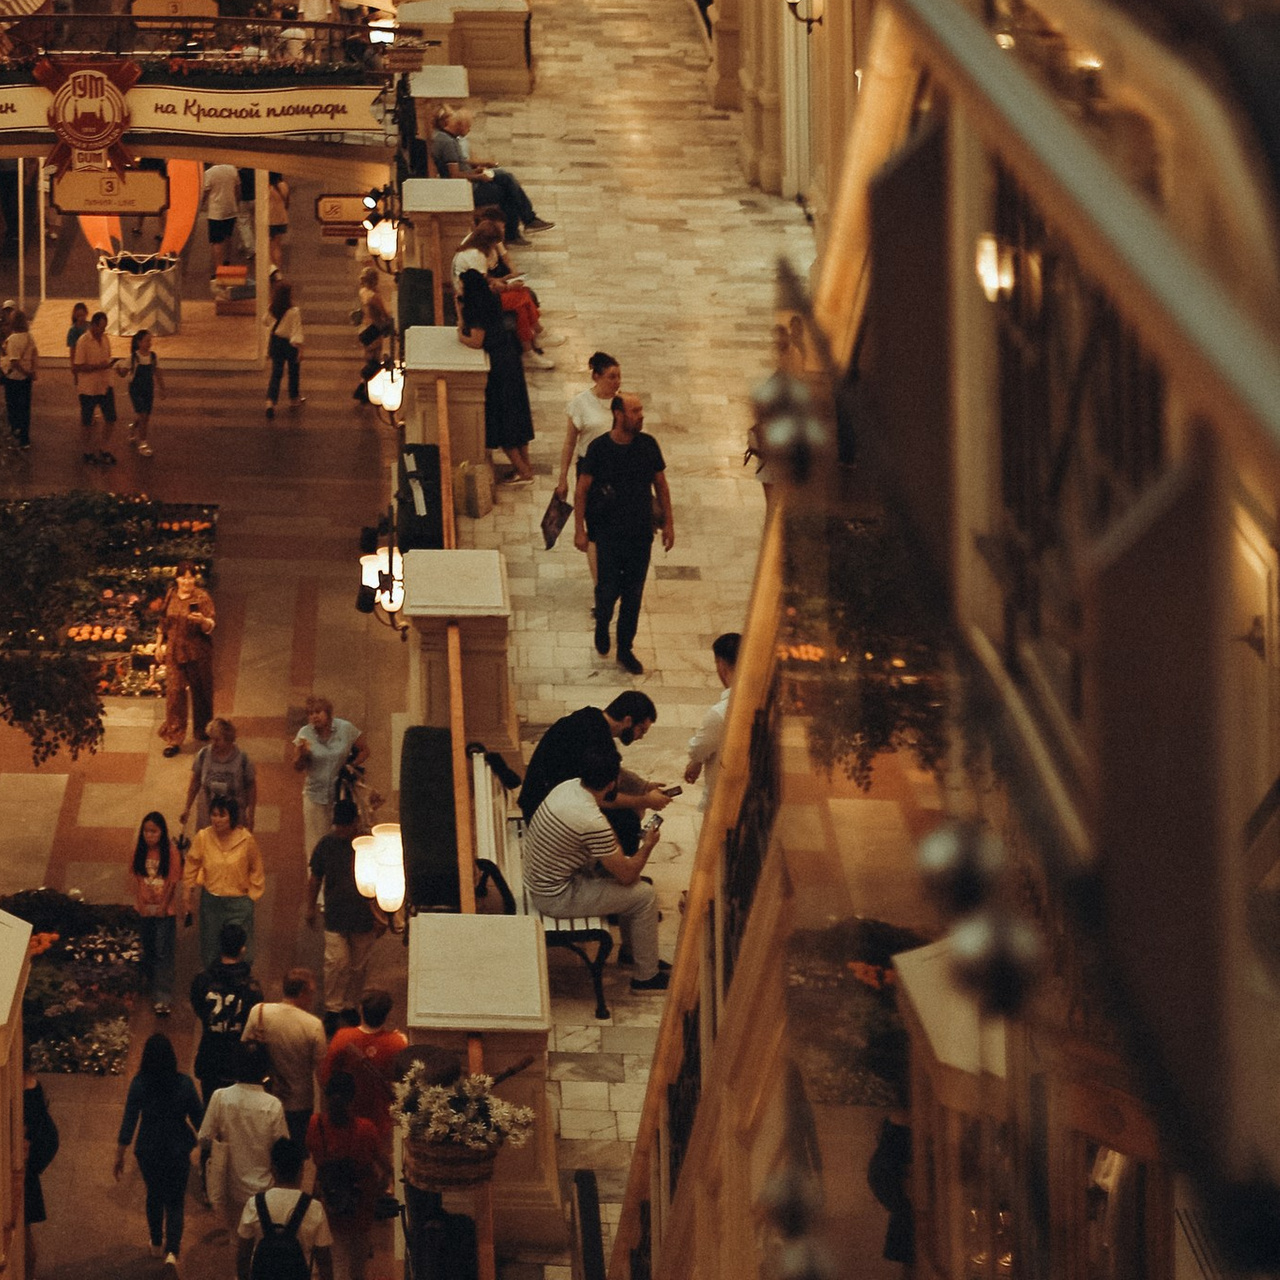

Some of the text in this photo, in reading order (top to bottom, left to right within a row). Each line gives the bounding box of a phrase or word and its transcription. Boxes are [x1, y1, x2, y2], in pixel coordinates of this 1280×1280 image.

[72, 74, 106, 99] ГУМ
[154, 98, 349, 123] на Красной площади
[105, 180, 115, 193] 3
